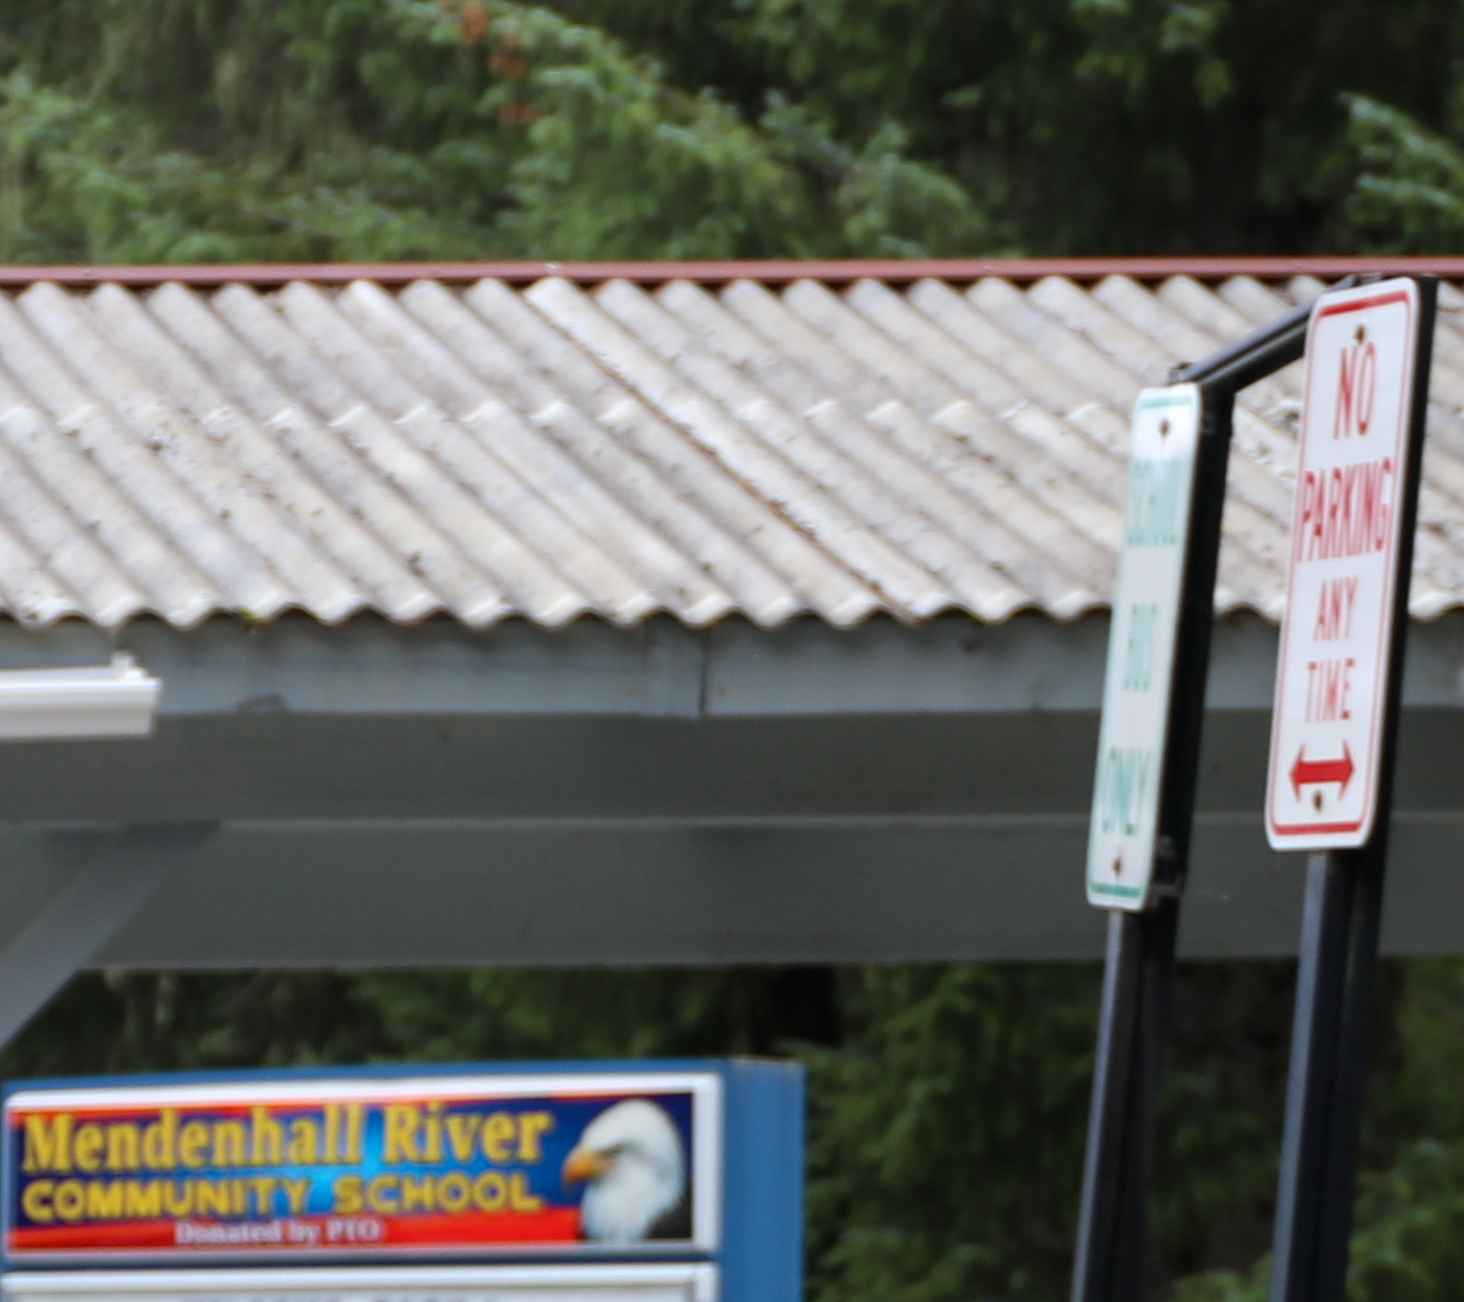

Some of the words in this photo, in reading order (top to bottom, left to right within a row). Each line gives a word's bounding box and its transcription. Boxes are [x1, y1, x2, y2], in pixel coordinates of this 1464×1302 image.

[1332, 342, 1378, 440] NO
[1296, 457, 1393, 562] PARKING
[1313, 576, 1359, 642] ANY
[1306, 658, 1355, 722] TIME
[21, 1103, 363, 1173] Mendenhall
[382, 1101, 554, 1164] River
[21, 1175, 312, 1221] COMMUNITY
[333, 1172, 543, 1215] SCHOOL
[174, 1220, 283, 1245] Donated
[294, 1220, 320, 1246] by
[326, 1219, 383, 1243] PTO
